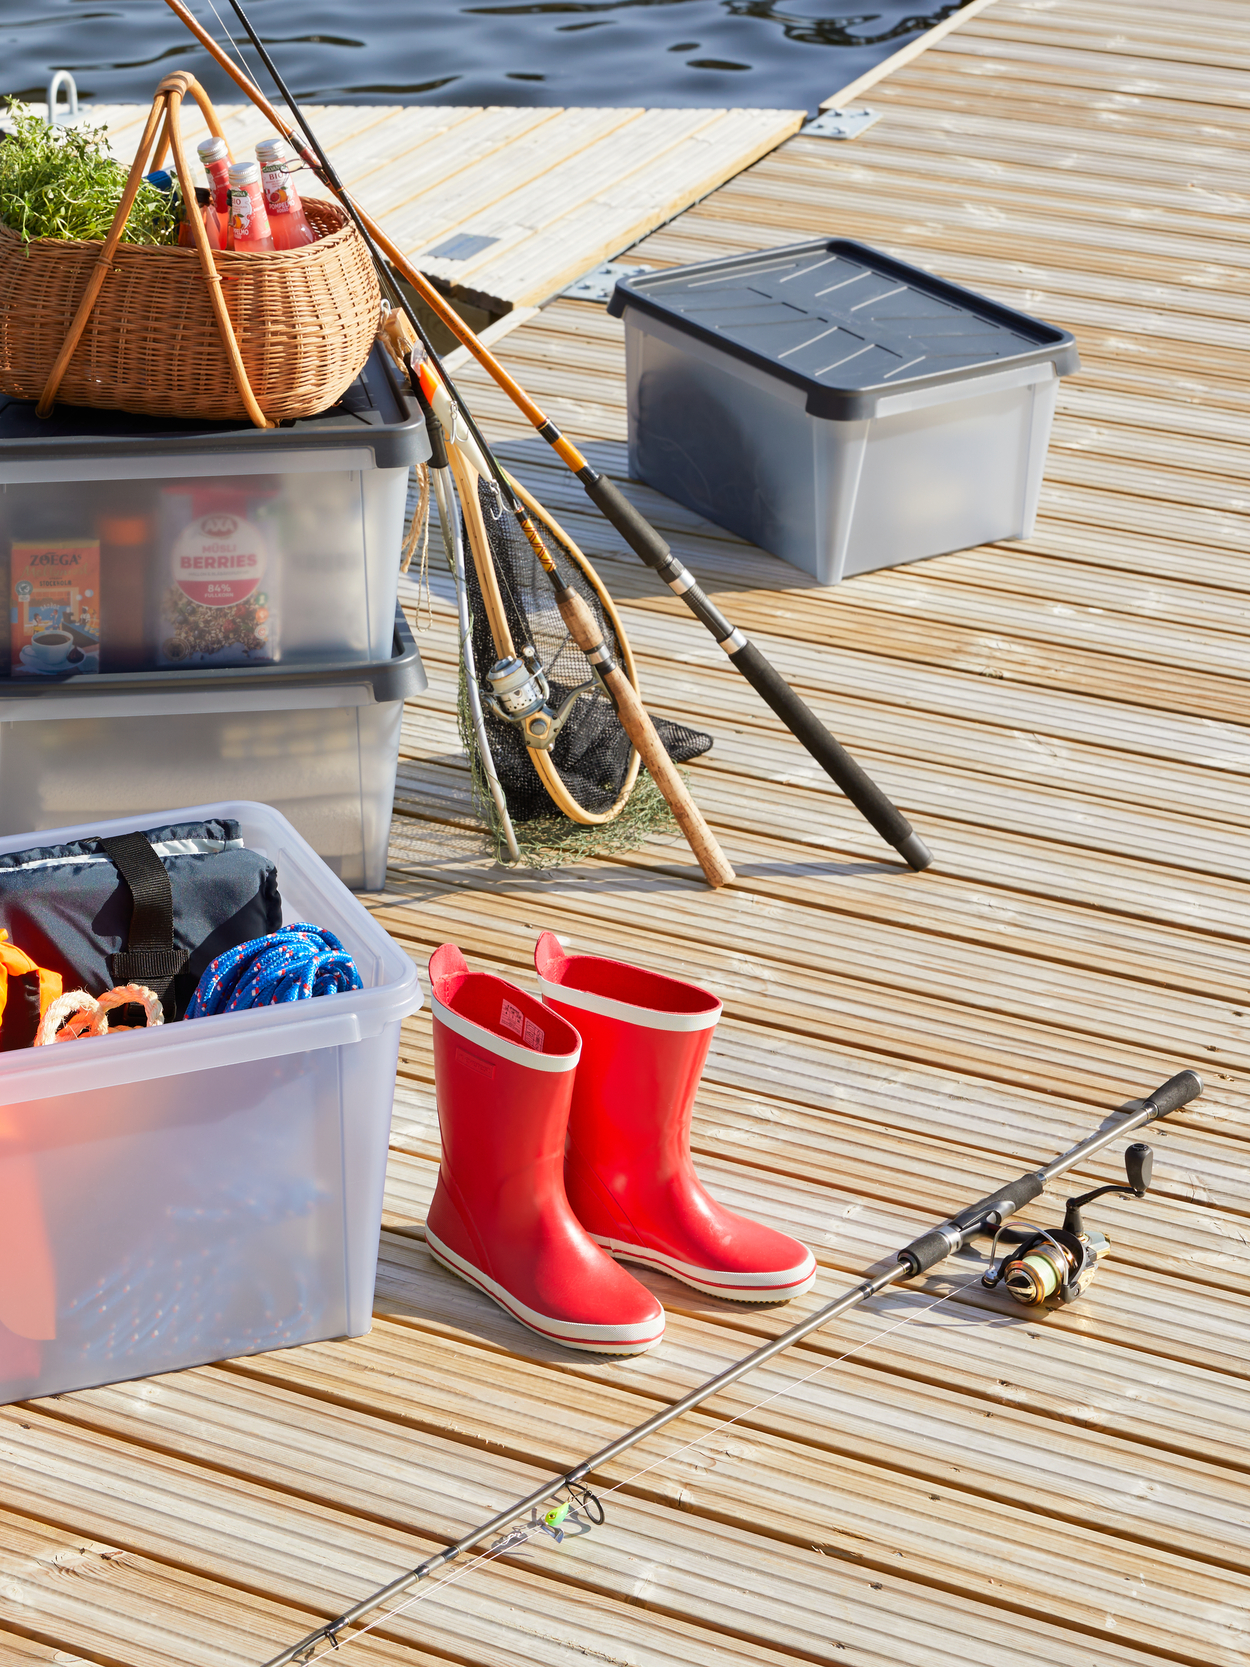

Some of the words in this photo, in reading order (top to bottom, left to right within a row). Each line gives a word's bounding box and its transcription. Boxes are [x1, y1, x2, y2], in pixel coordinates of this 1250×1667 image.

[268, 172, 284, 180] BIO
[203, 519, 236, 532] AXA
[202, 542, 237, 553] MÜSLI
[180, 553, 257, 569] BERRIES
[207, 583, 231, 593] 84%
